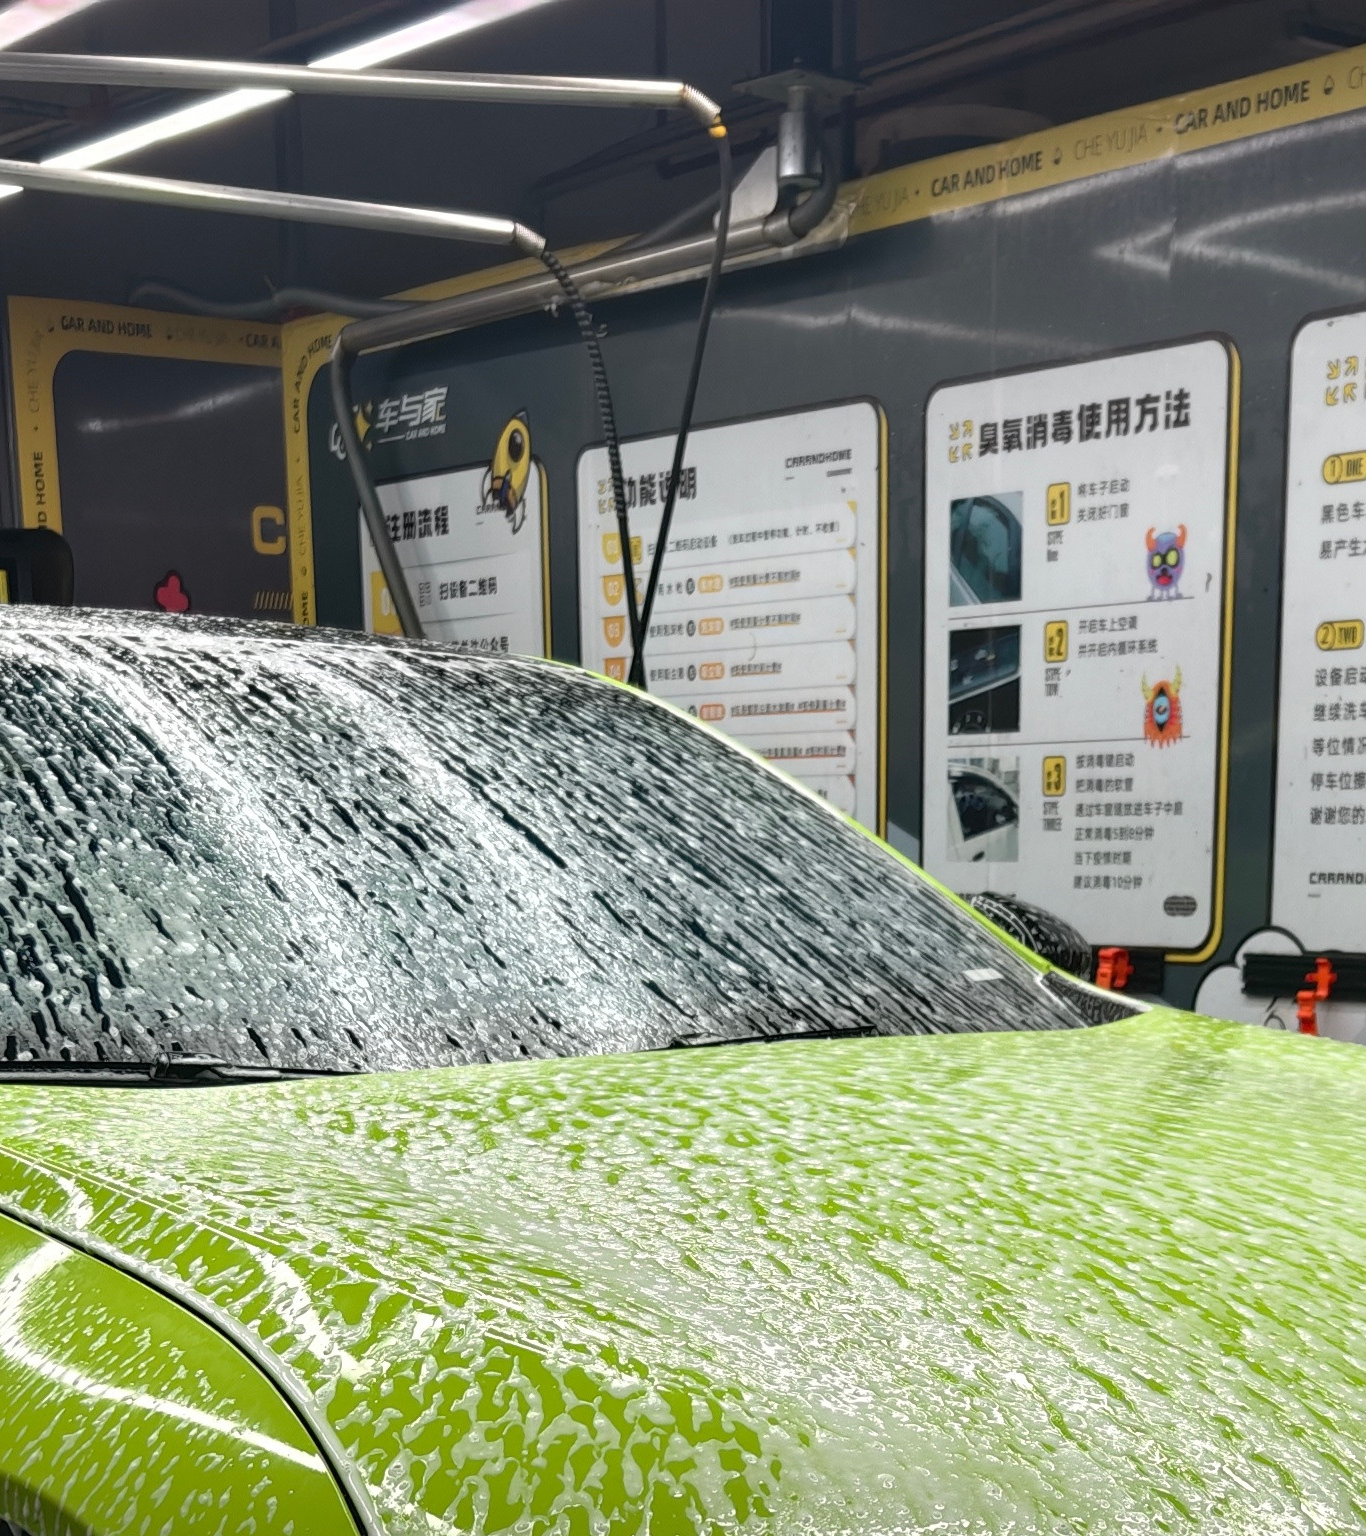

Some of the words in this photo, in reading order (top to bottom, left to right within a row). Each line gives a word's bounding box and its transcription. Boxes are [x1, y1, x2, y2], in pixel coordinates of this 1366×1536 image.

[1174, 108, 1208, 135] CAR
[1212, 96, 1252, 126] AND
[1256, 79, 1310, 114] HOME
[931, 174, 960, 197] CAR
[964, 165, 997, 190] AND
[999, 150, 1043, 180] HOME
[61, 315, 85, 331] CAR
[88, 319, 114, 334] AND
[117, 321, 153, 337] HOME
[376, 385, 448, 434] 车与家
[979, 388, 1191, 457] 臭氧消毒使用方法
[33, 451, 44, 508] HOME
[386, 505, 449, 542] 注册流程
[1320, 626, 1330, 646] 2
[1339, 627, 1357, 646] TWO
